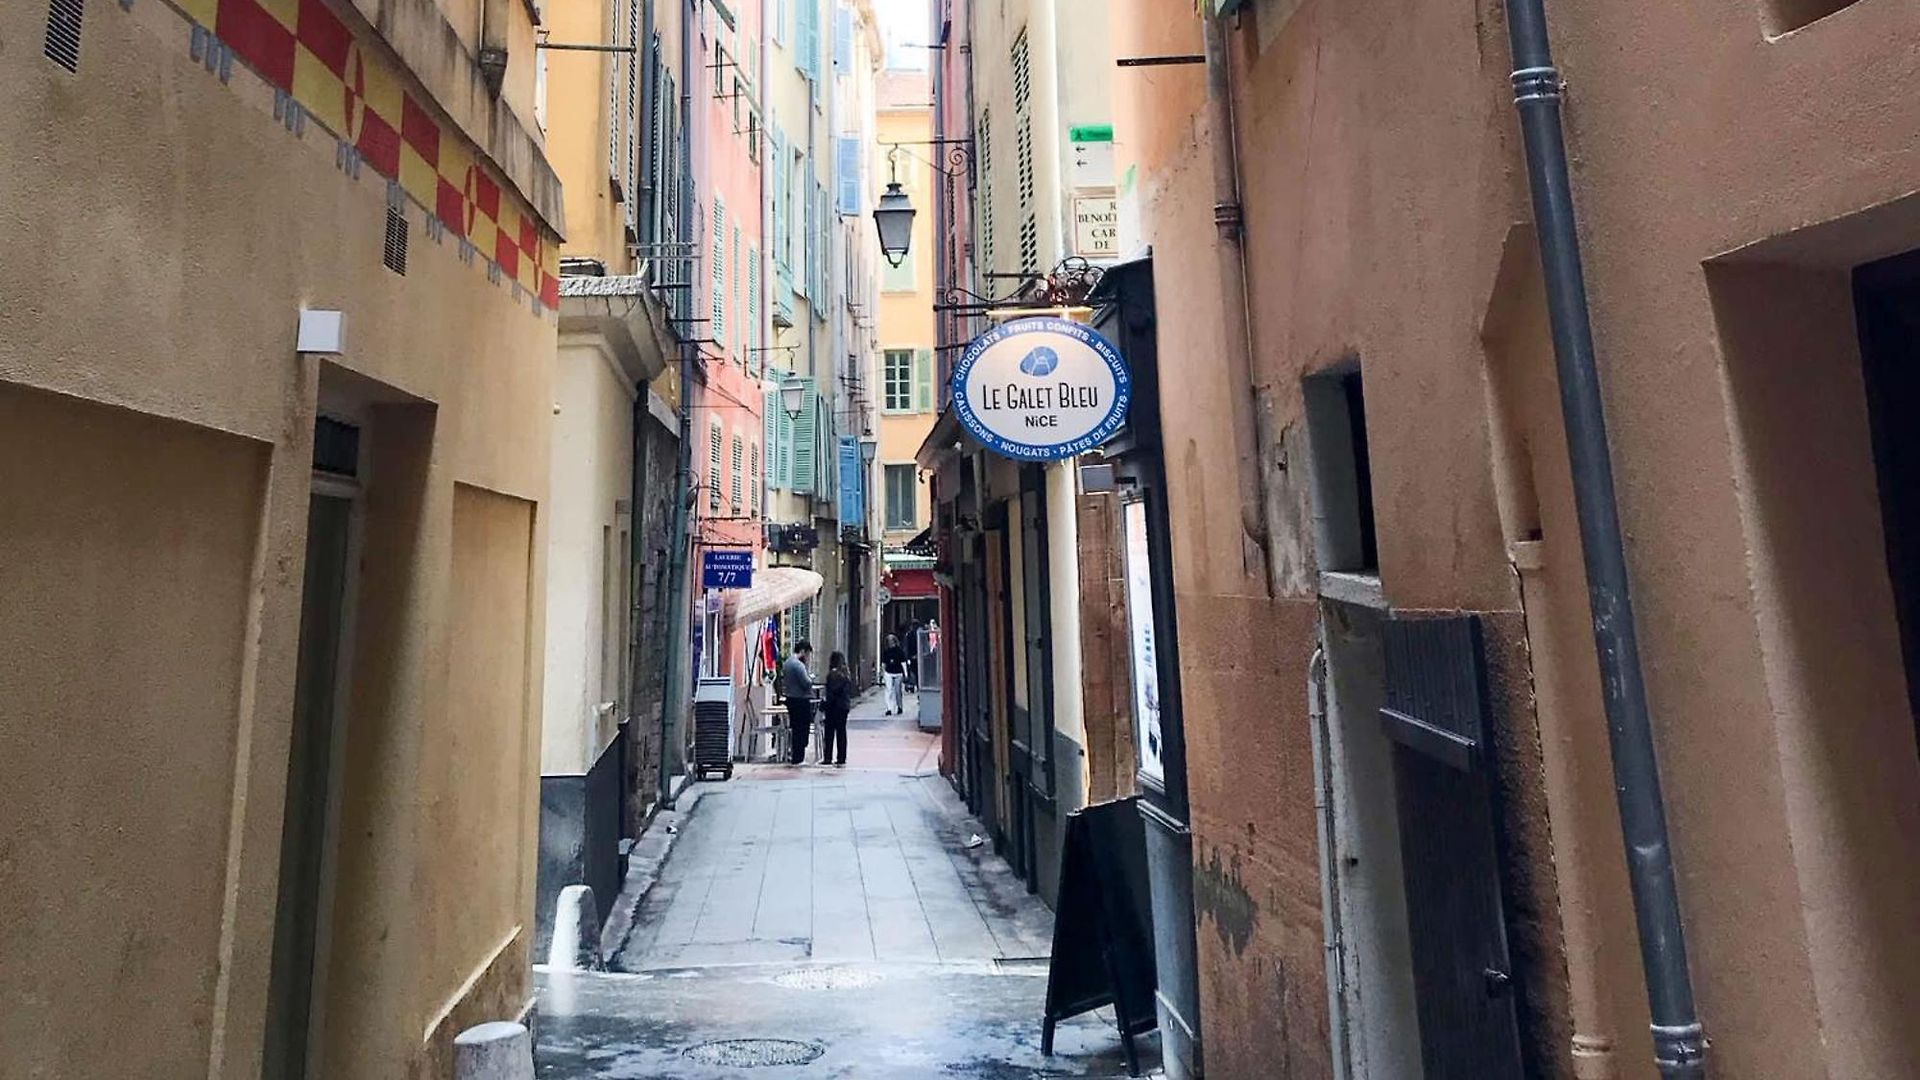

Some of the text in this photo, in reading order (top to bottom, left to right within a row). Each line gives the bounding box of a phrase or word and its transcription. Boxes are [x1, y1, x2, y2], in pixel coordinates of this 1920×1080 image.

[1094, 240, 1110, 250] DE
[955, 321, 1128, 384] CHOCOLATS FRUITS CONFITS BISCUITS
[954, 391, 1128, 457] CALISSONS NOUGATS PÂTES DE FRUITS
[718, 571, 736, 584] 7/7
